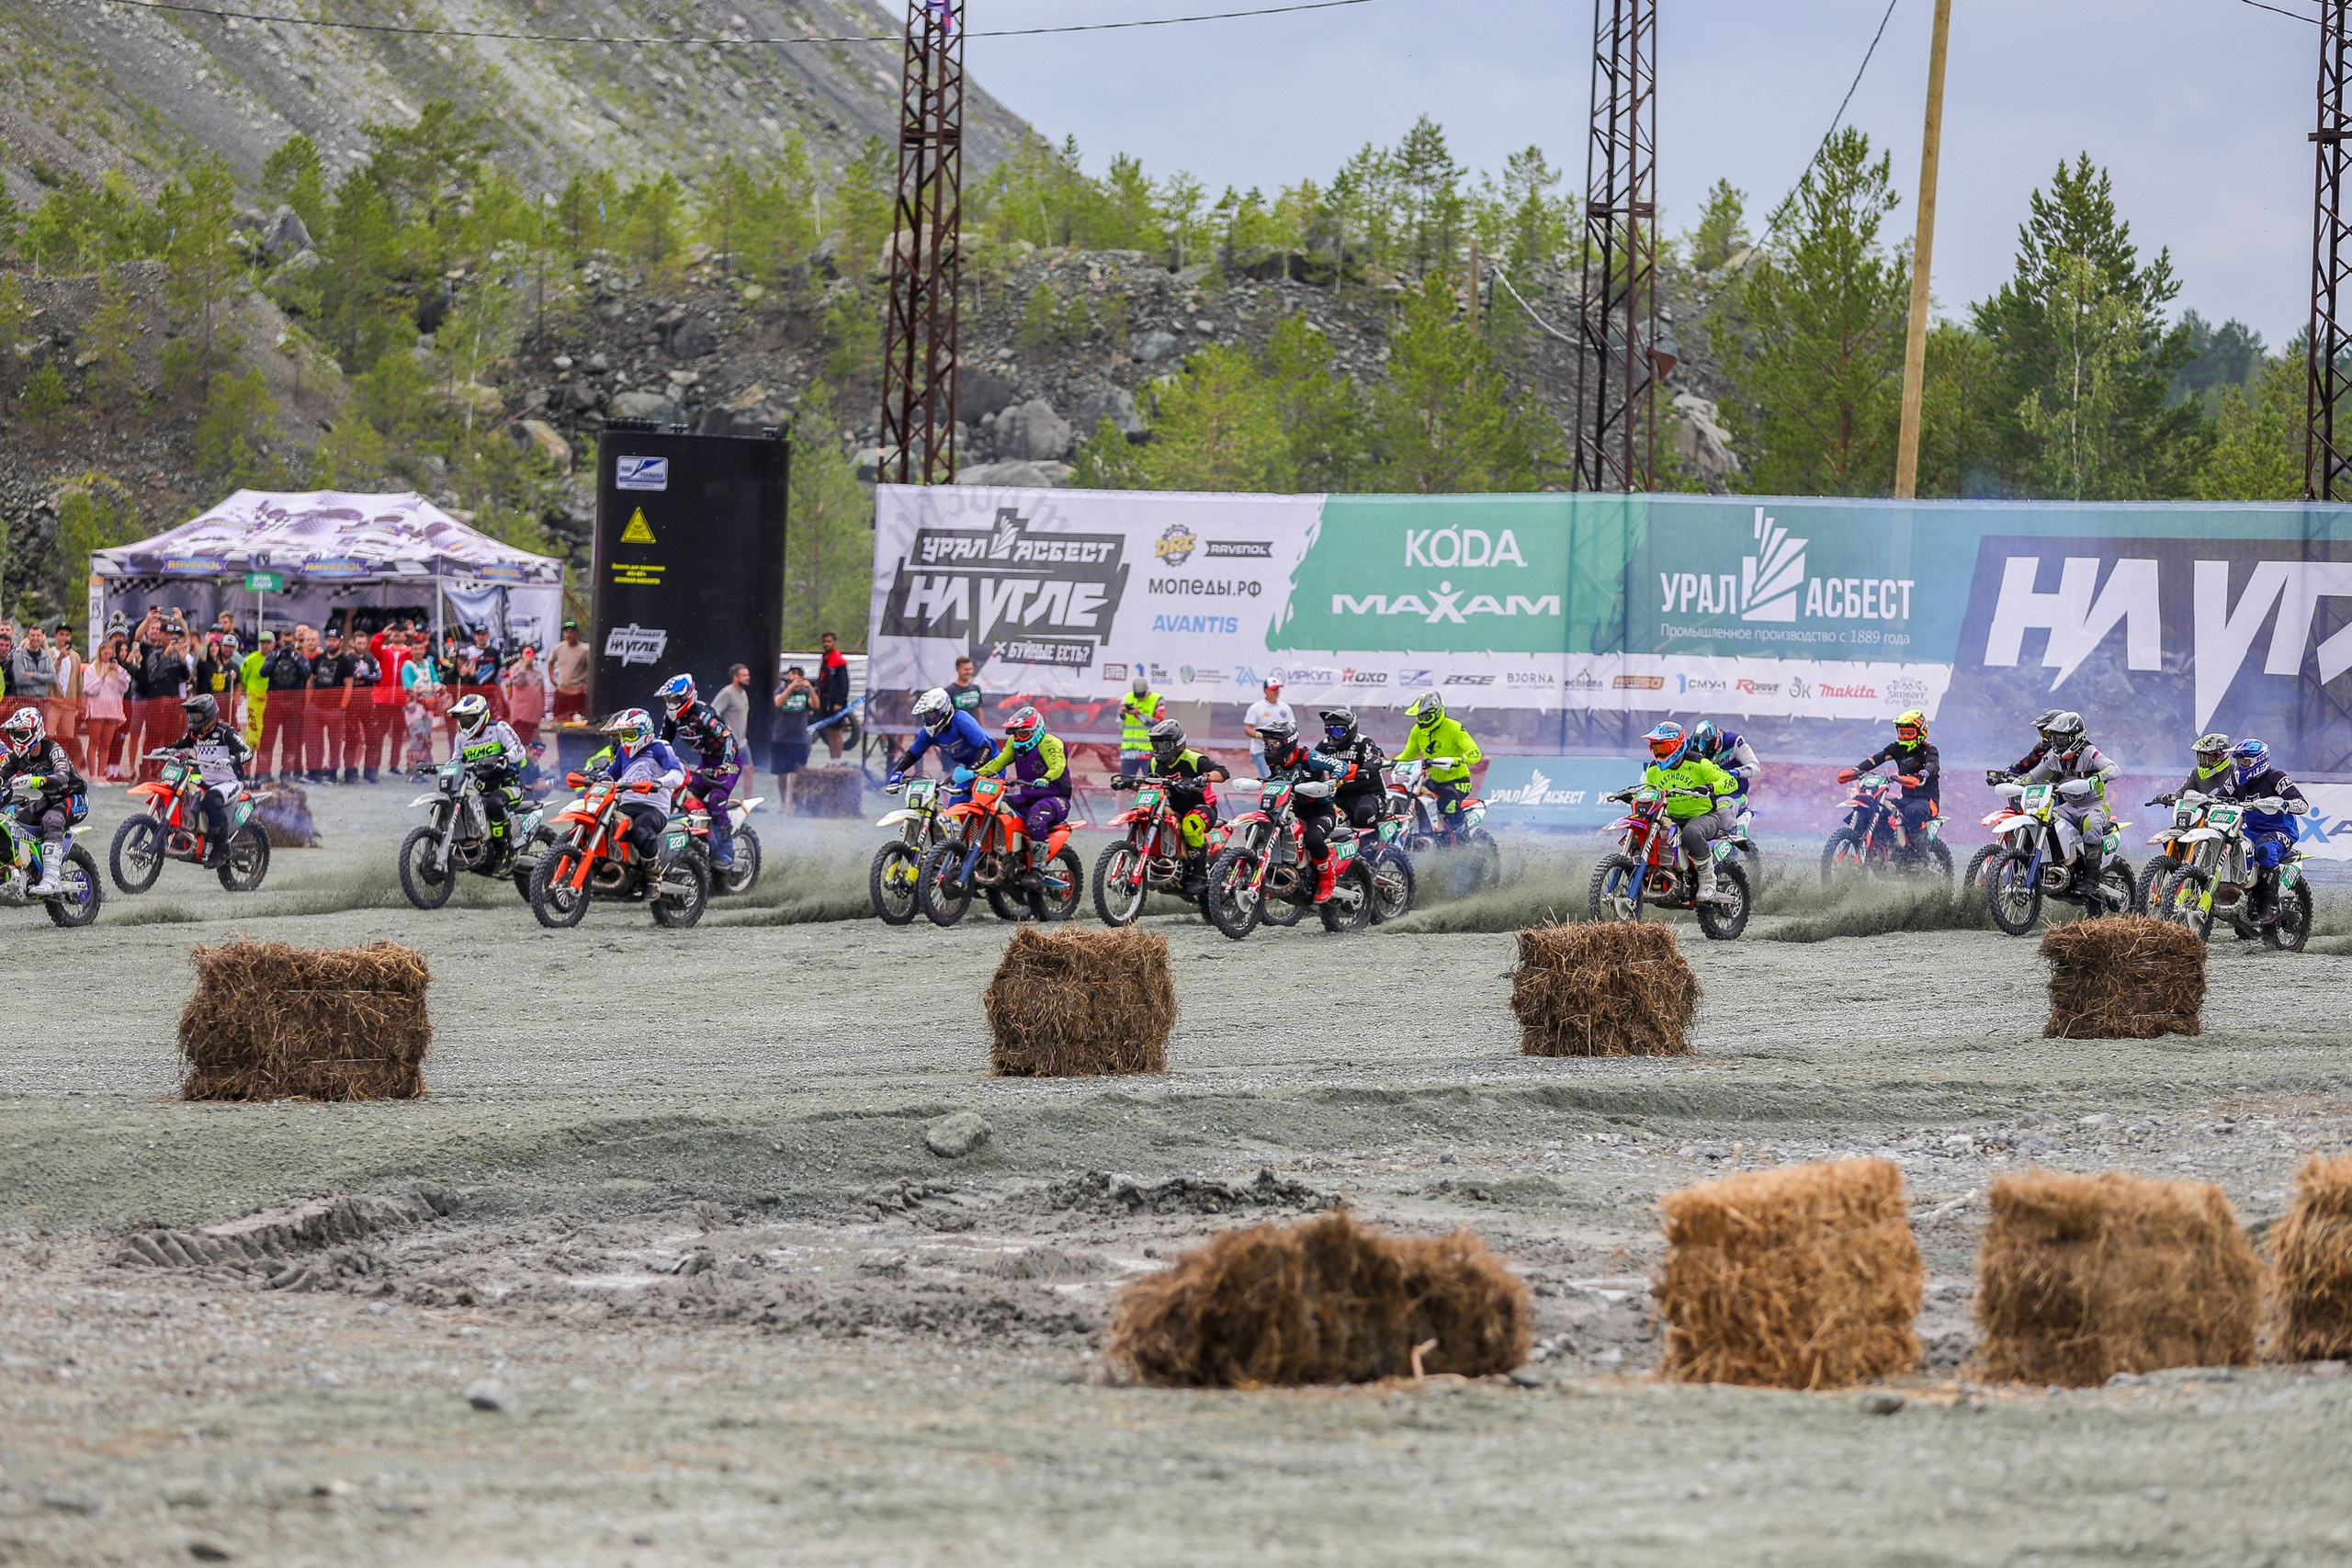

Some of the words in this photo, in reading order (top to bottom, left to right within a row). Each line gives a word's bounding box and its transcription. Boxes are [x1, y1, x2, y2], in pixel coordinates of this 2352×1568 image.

[922, 536, 989, 563] УРАЛ
[1012, 539, 1116, 563] АСБЕСТ
[1155, 533, 1197, 558] DRC
[1210, 544, 1268, 555] RAVENOL
[167, 559, 222, 571] RAVENOL
[304, 561, 363, 572] RAVENOL
[1332, 580, 1561, 624] MAXAM
[1660, 572, 1736, 615] УРАЛ
[1804, 577, 1916, 620] АСБЕСТ
[903, 575, 970, 628] НА
[978, 577, 1109, 646] УГЛЕ
[1152, 615, 1239, 634] AVANTIS
[1984, 556, 2162, 693] НА
[1660, 623, 1752, 641] Промышленное
[1754, 628, 1837, 644] производство
[1838, 631, 1847, 643] с
[1849, 629, 1881, 644] 1889
[1883, 633, 1910, 646] года
[1008, 640, 1055, 660] БУЙНЫЕ
[1057, 645, 1091, 662] ЕСТЬ?
[1287, 671, 1332, 682] ИРКУТ
[1342, 671, 1388, 683] ROXO
[1507, 672, 1555, 684] BJORNA
[1688, 679, 1726, 690] СМУ-1
[1818, 683, 1877, 699] makita
[1138, 794, 1154, 804] 119
[1490, 788, 1521, 804] УРАЛ
[1543, 790, 1587, 805] АСБЕСТ
[523, 814, 537, 832] 228
[2213, 813, 2231, 821] 210
[670, 836, 684, 850] 227
[1341, 843, 1355, 857] 170
[1718, 841, 1731, 860] 195
[2106, 840, 2116, 851] 211
[2286, 866, 2299, 884] 210
